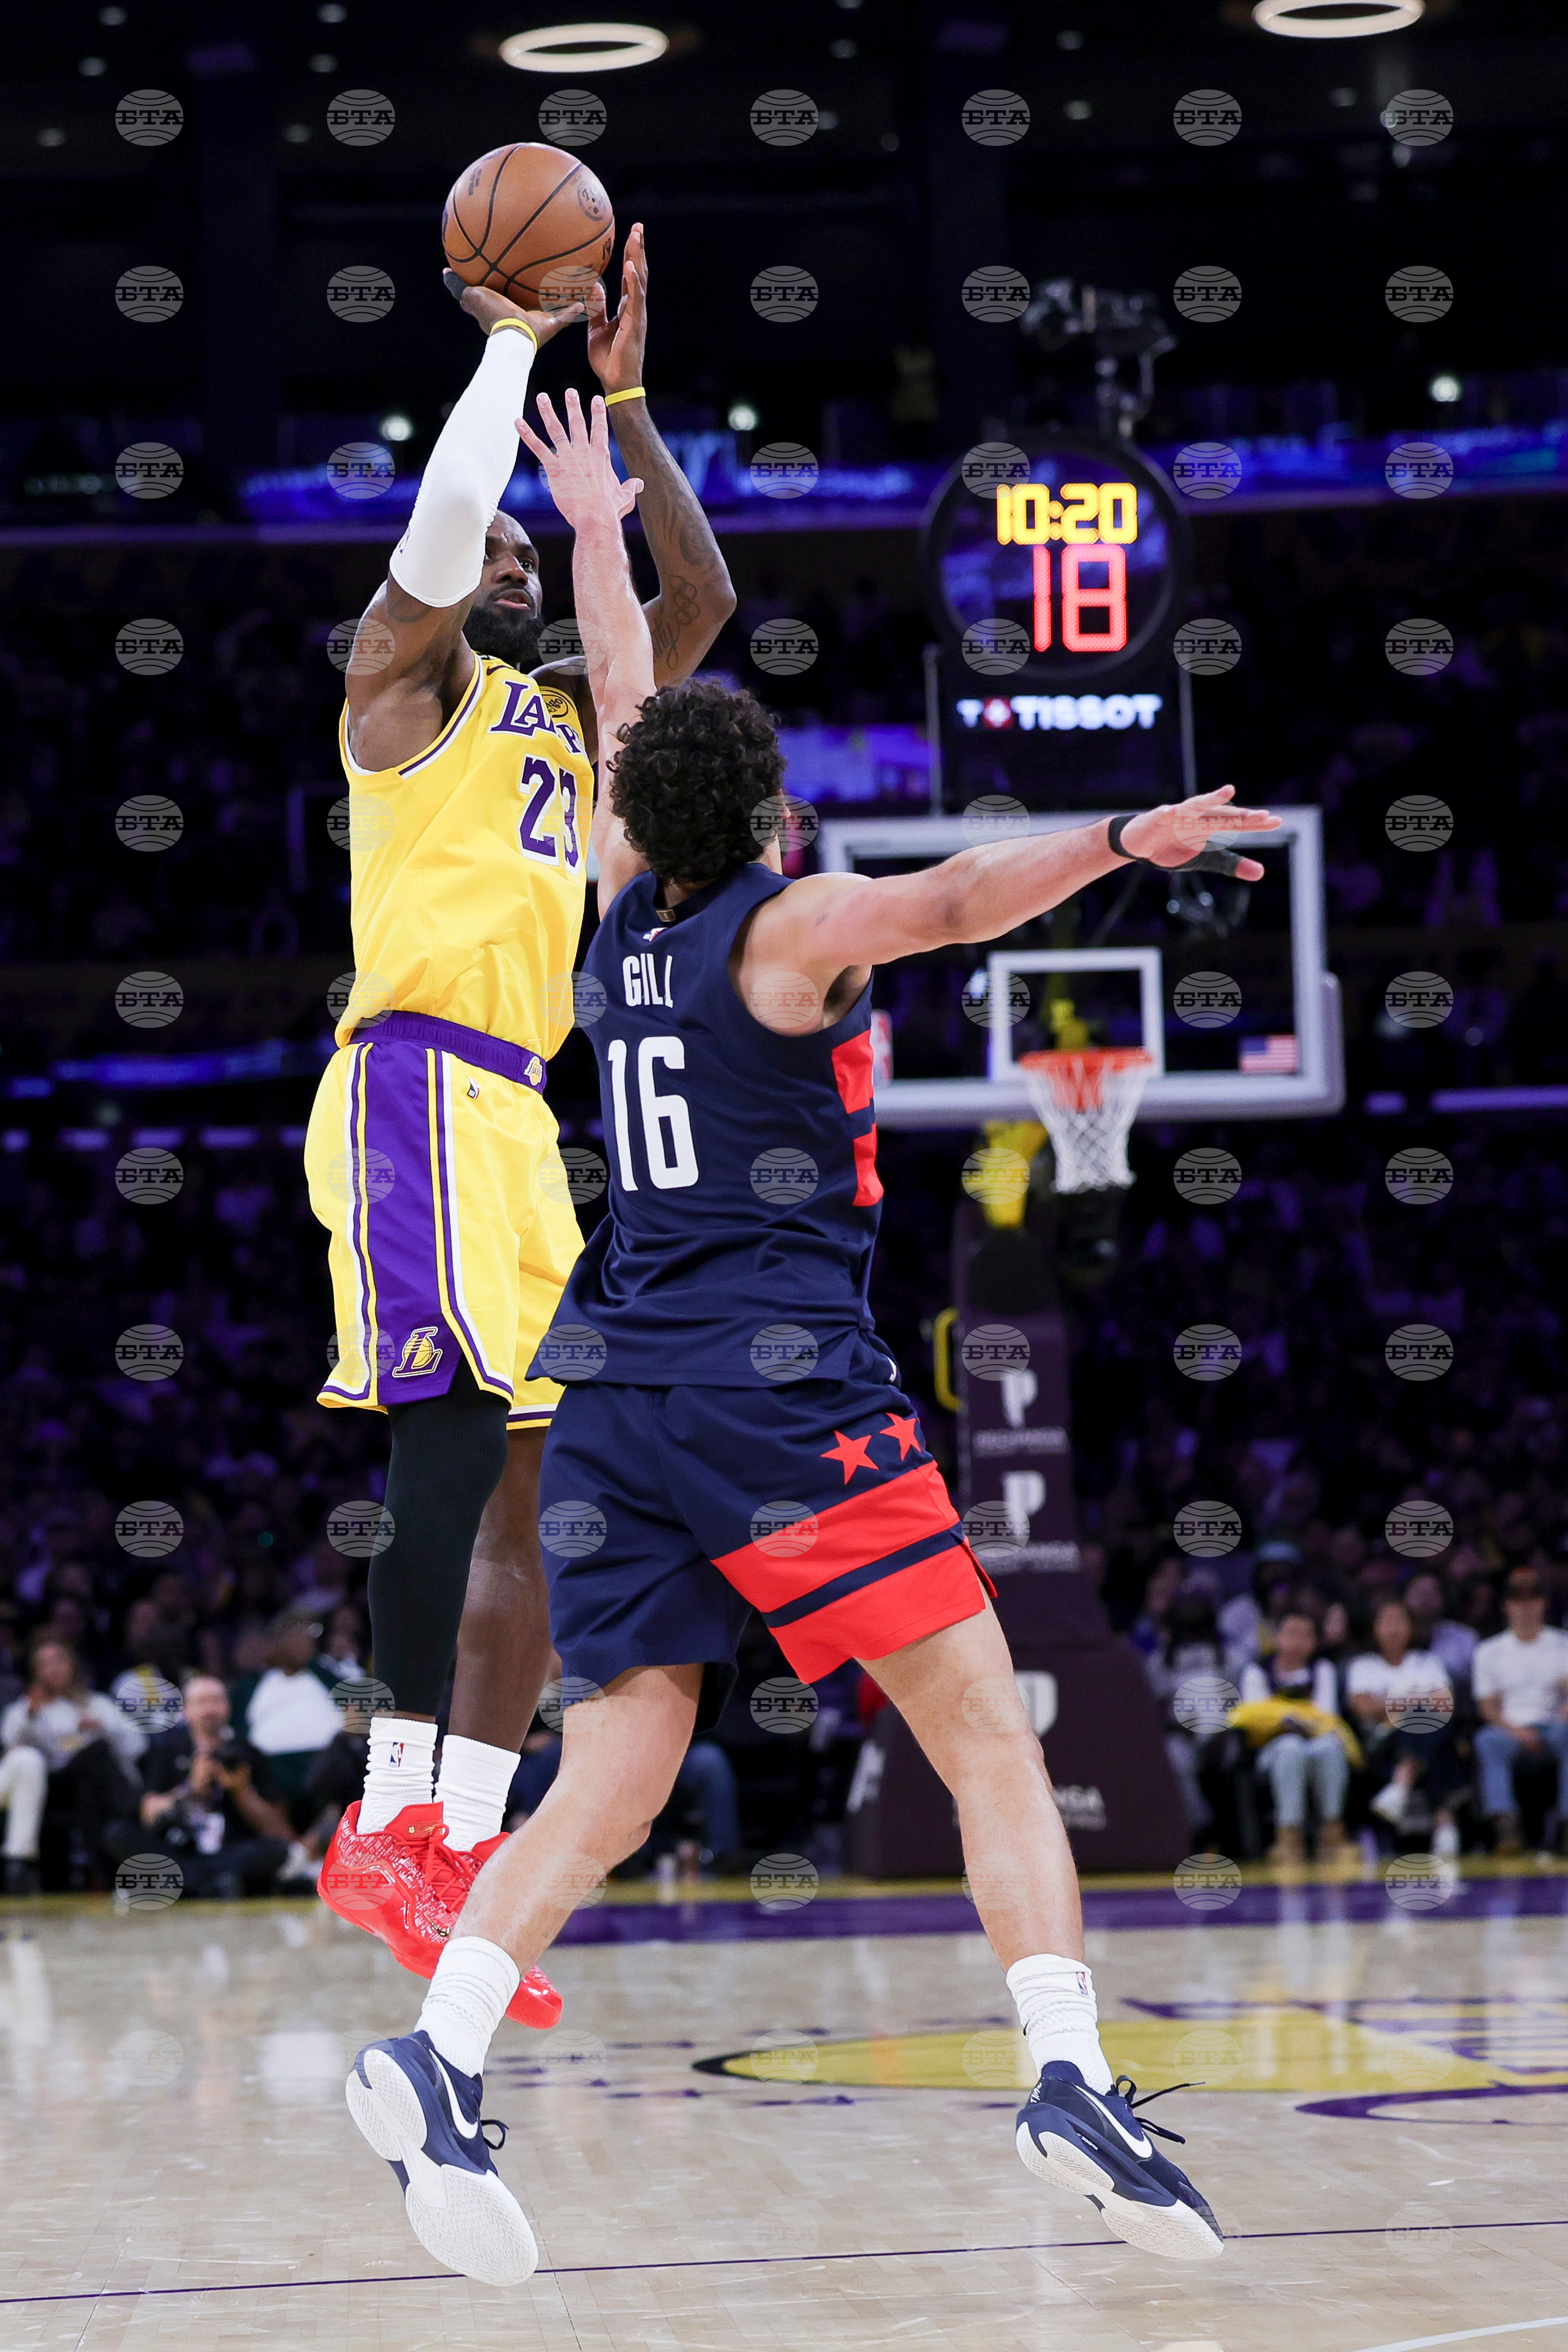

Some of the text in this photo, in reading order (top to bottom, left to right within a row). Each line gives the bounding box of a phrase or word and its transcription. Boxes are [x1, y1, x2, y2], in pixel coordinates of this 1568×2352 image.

[997, 483, 1137, 544] 10:20
[1033, 544, 1126, 652] 18
[1011, 694, 1162, 730] TISSOT
[518, 753, 581, 876] 23
[623, 953, 673, 1008] GILL
[608, 1036, 698, 1191] 16
